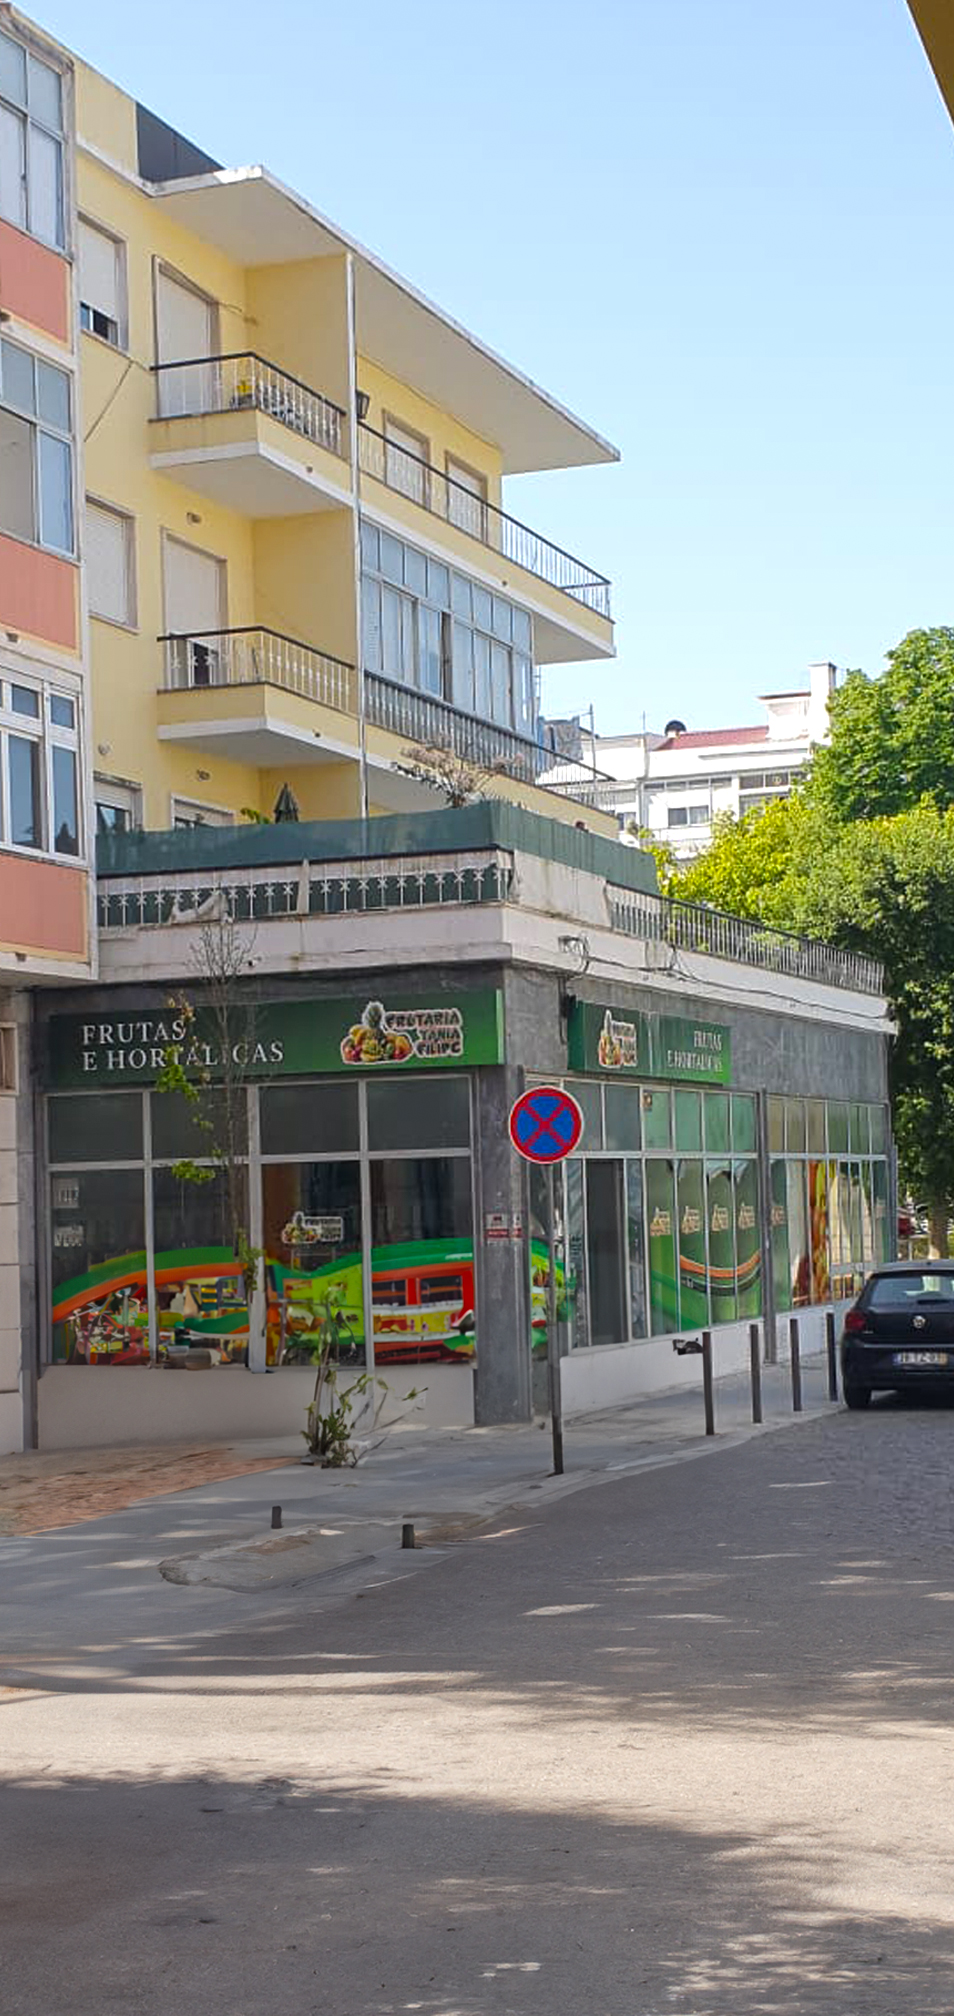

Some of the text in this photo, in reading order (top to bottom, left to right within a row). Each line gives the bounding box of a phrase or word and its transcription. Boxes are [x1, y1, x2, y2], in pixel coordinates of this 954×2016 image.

[384, 1009, 462, 1028] FRUTARIA
[82, 1020, 187, 1045] FRUTAS
[83, 1052, 97, 1071] E
